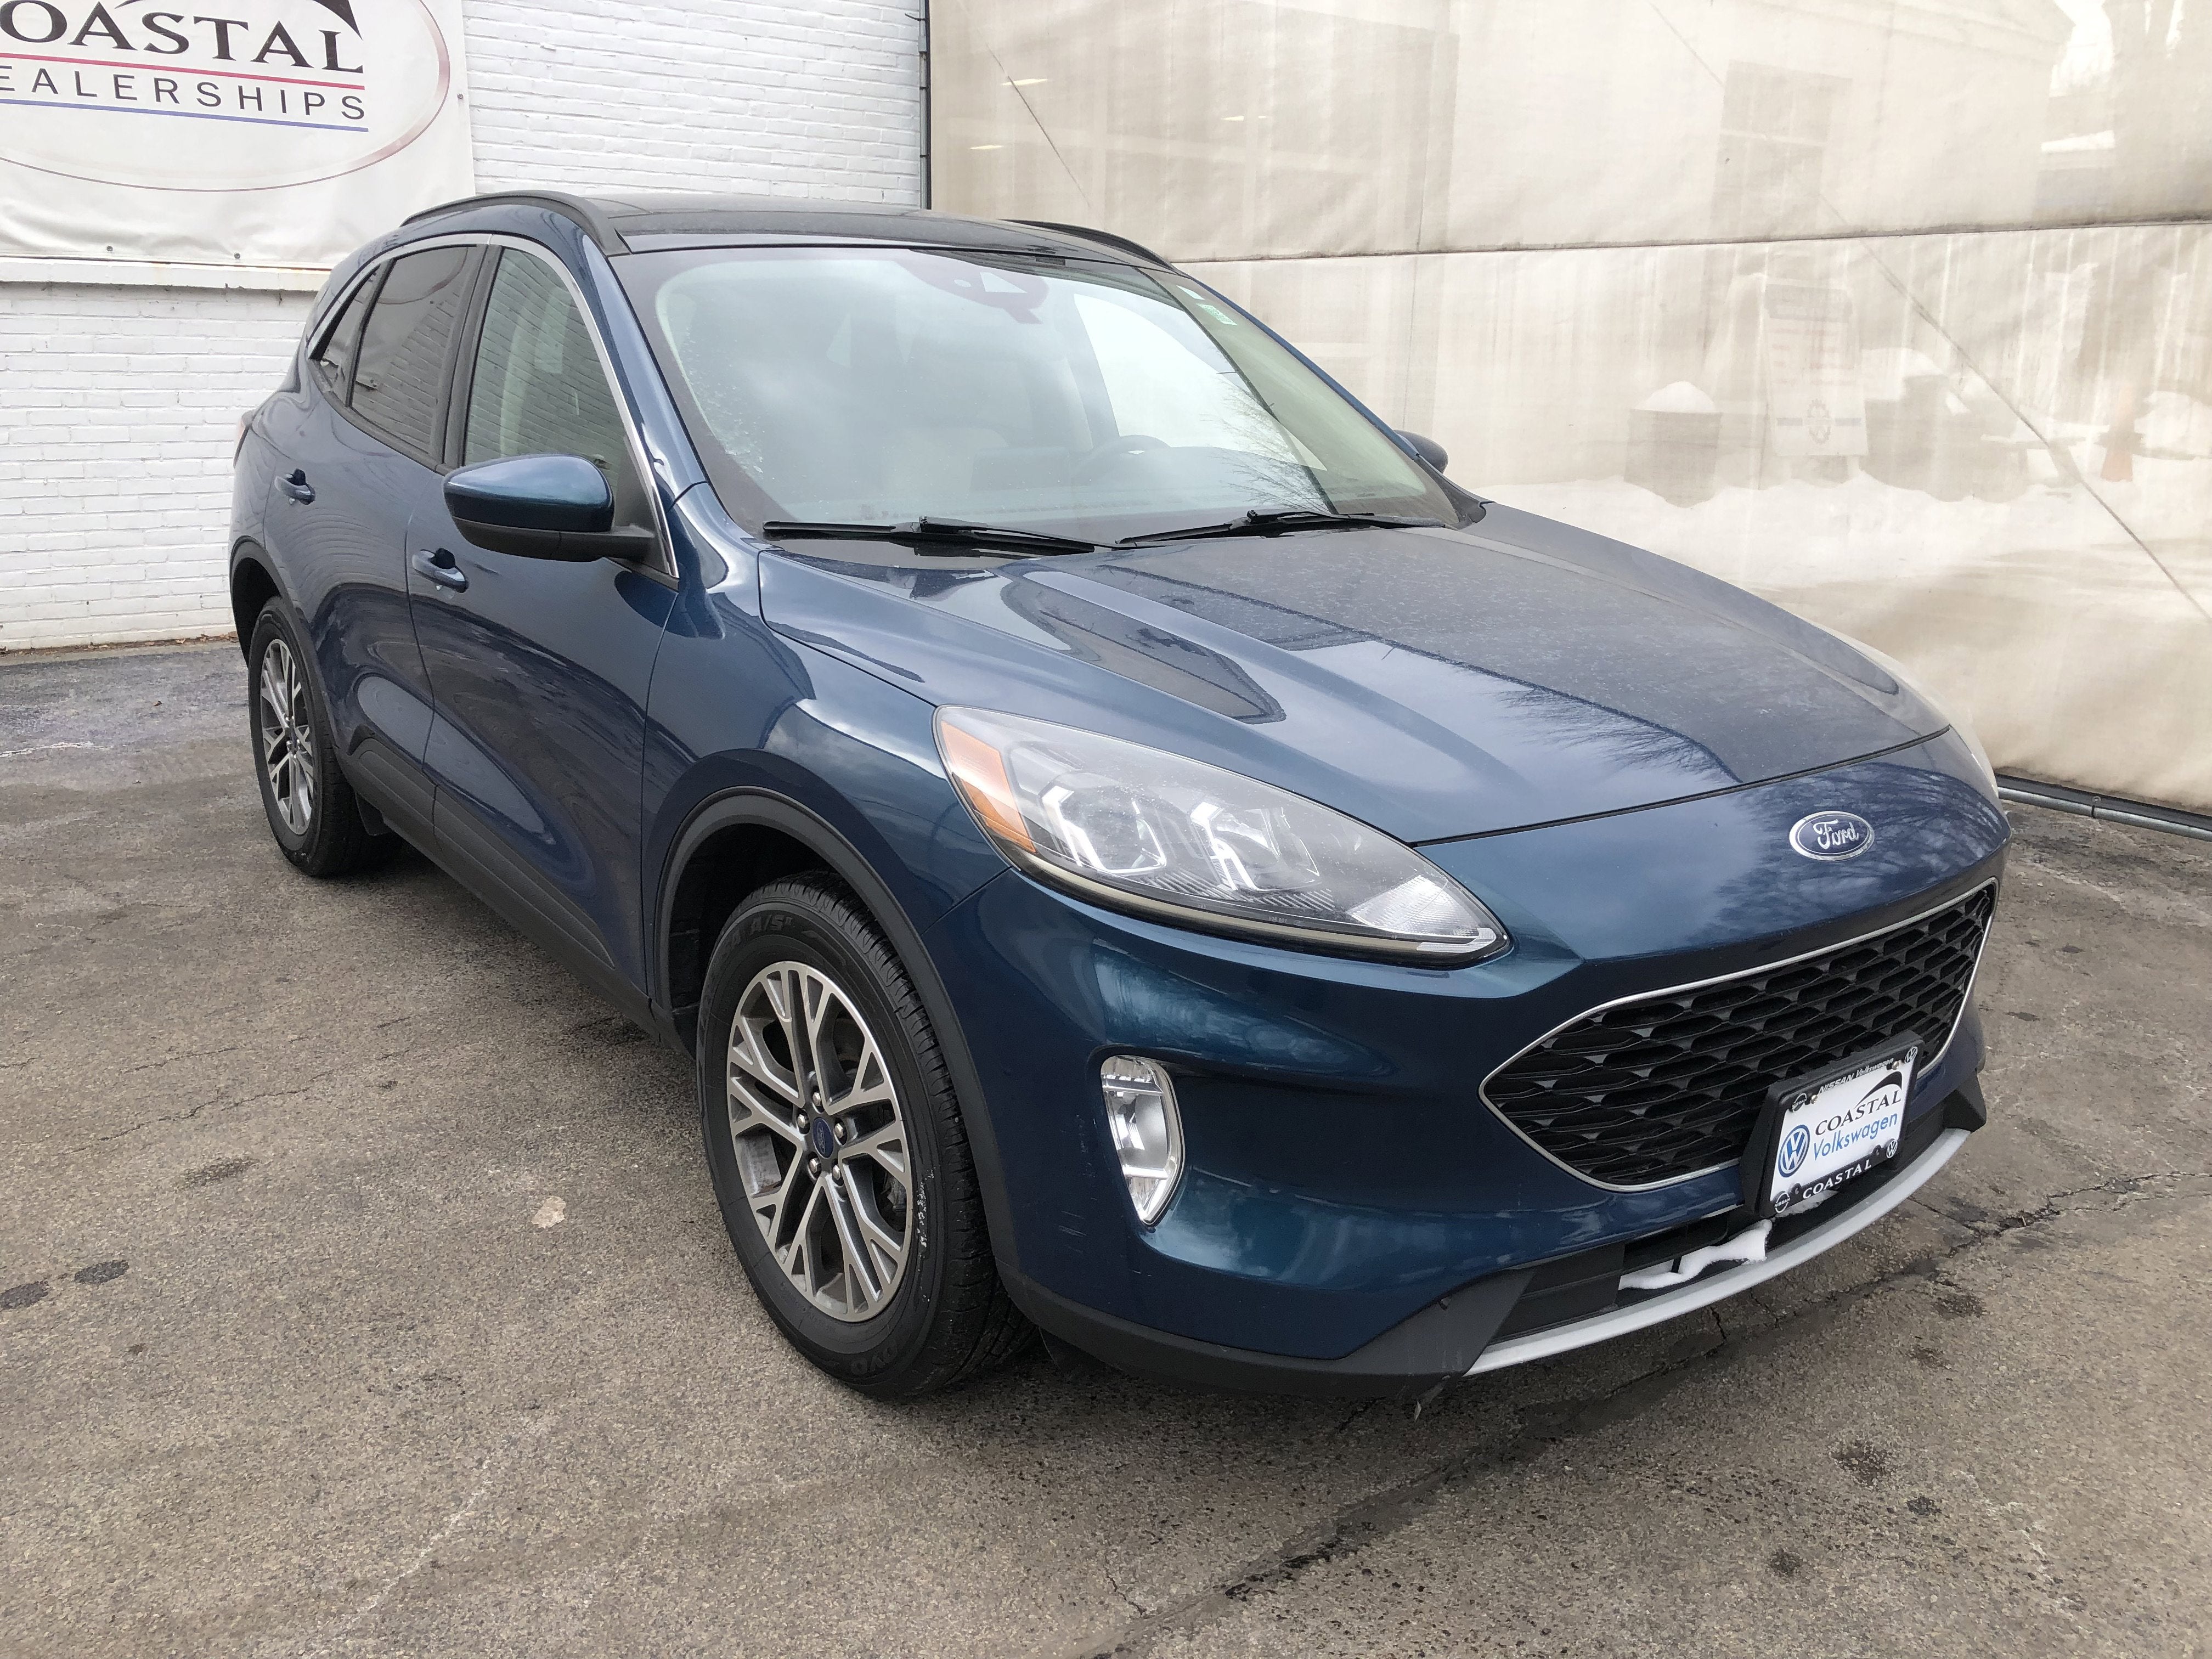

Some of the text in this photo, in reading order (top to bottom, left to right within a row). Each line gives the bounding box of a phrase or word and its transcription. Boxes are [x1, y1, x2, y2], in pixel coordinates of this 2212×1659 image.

[1813, 819, 1859, 849] Ford
[1819, 1073, 1854, 1095] NISSAN
[1815, 1090, 1901, 1136] COASTAL
[1814, 1113, 1898, 1160] Volkswagen
[1803, 1159, 1872, 1199] COASTAL
